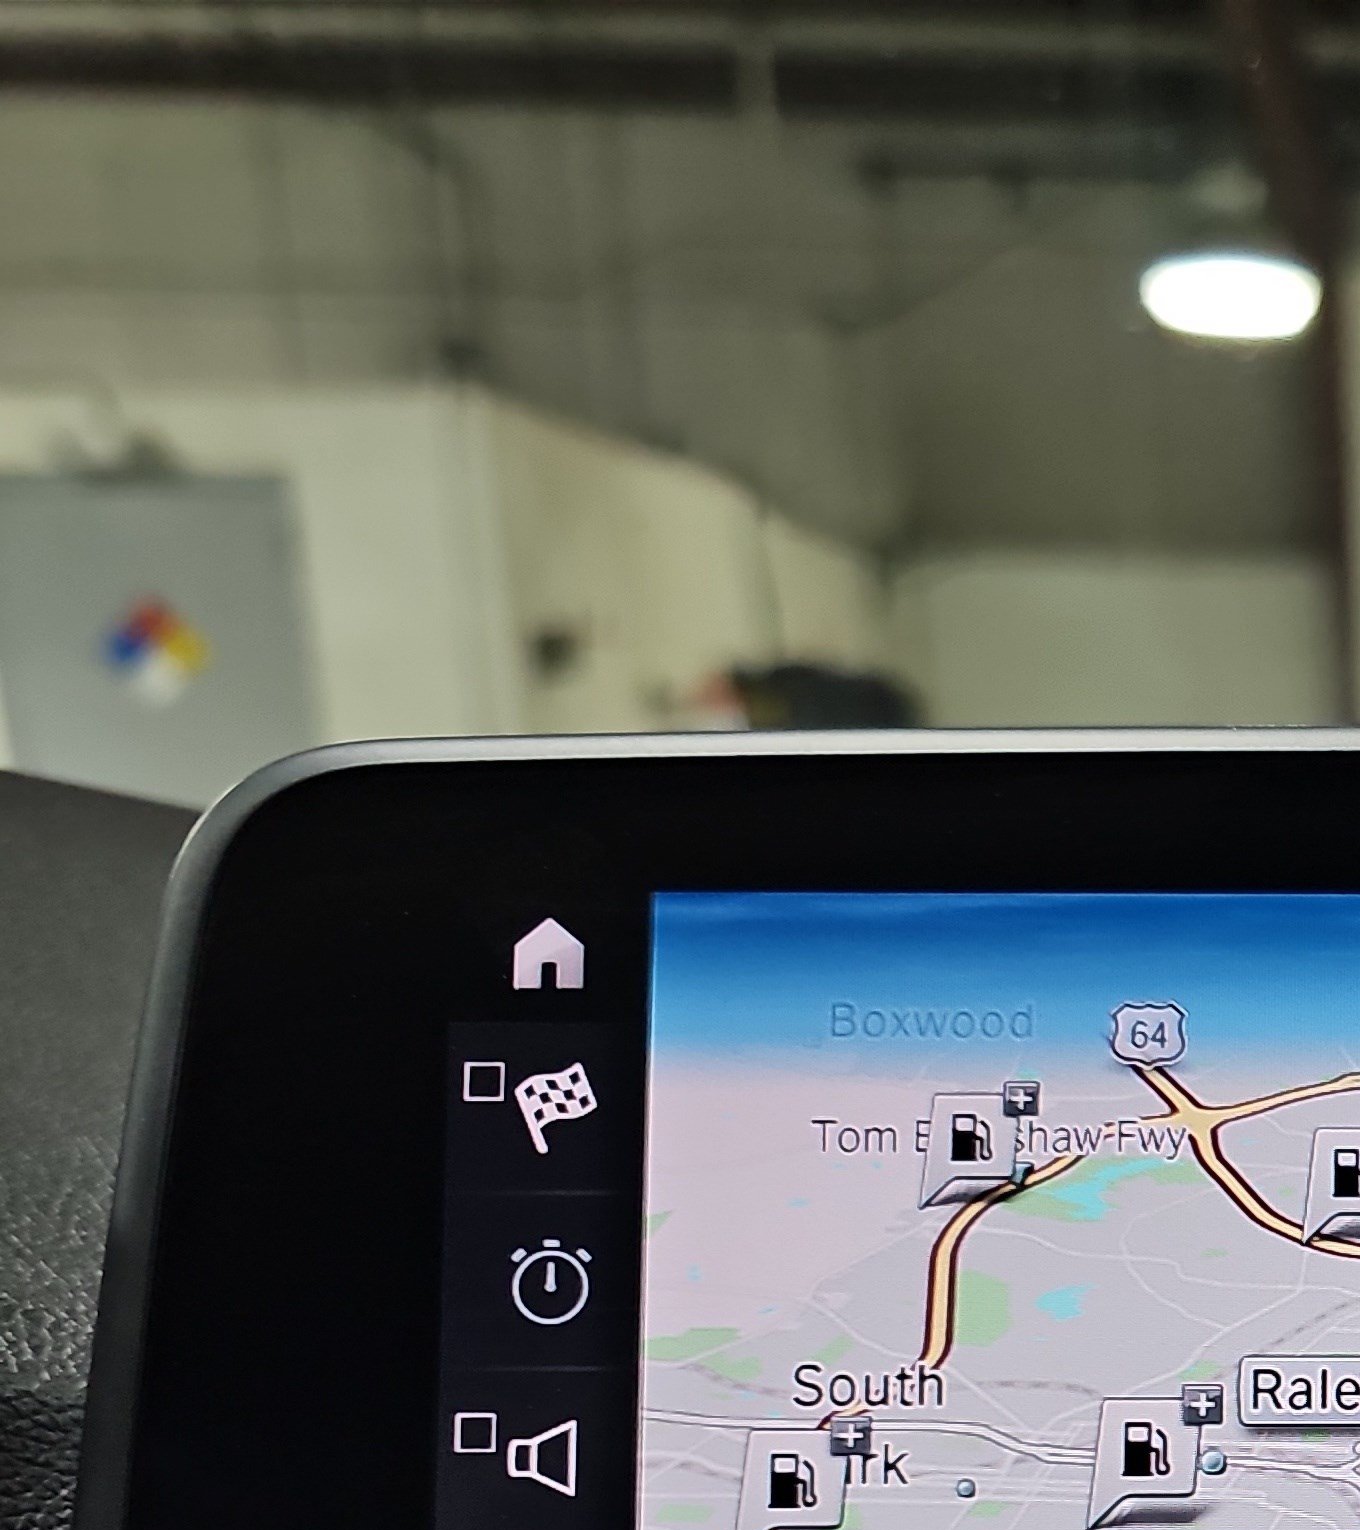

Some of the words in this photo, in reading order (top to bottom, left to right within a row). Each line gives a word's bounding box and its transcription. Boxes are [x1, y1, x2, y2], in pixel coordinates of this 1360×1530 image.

[830, 1003, 1033, 1041] Boxwood
[1129, 1020, 1168, 1050] 64
[811, 1119, 897, 1154] Tom
[1116, 1120, 1186, 1159] Fwy
[794, 1365, 945, 1407] South
